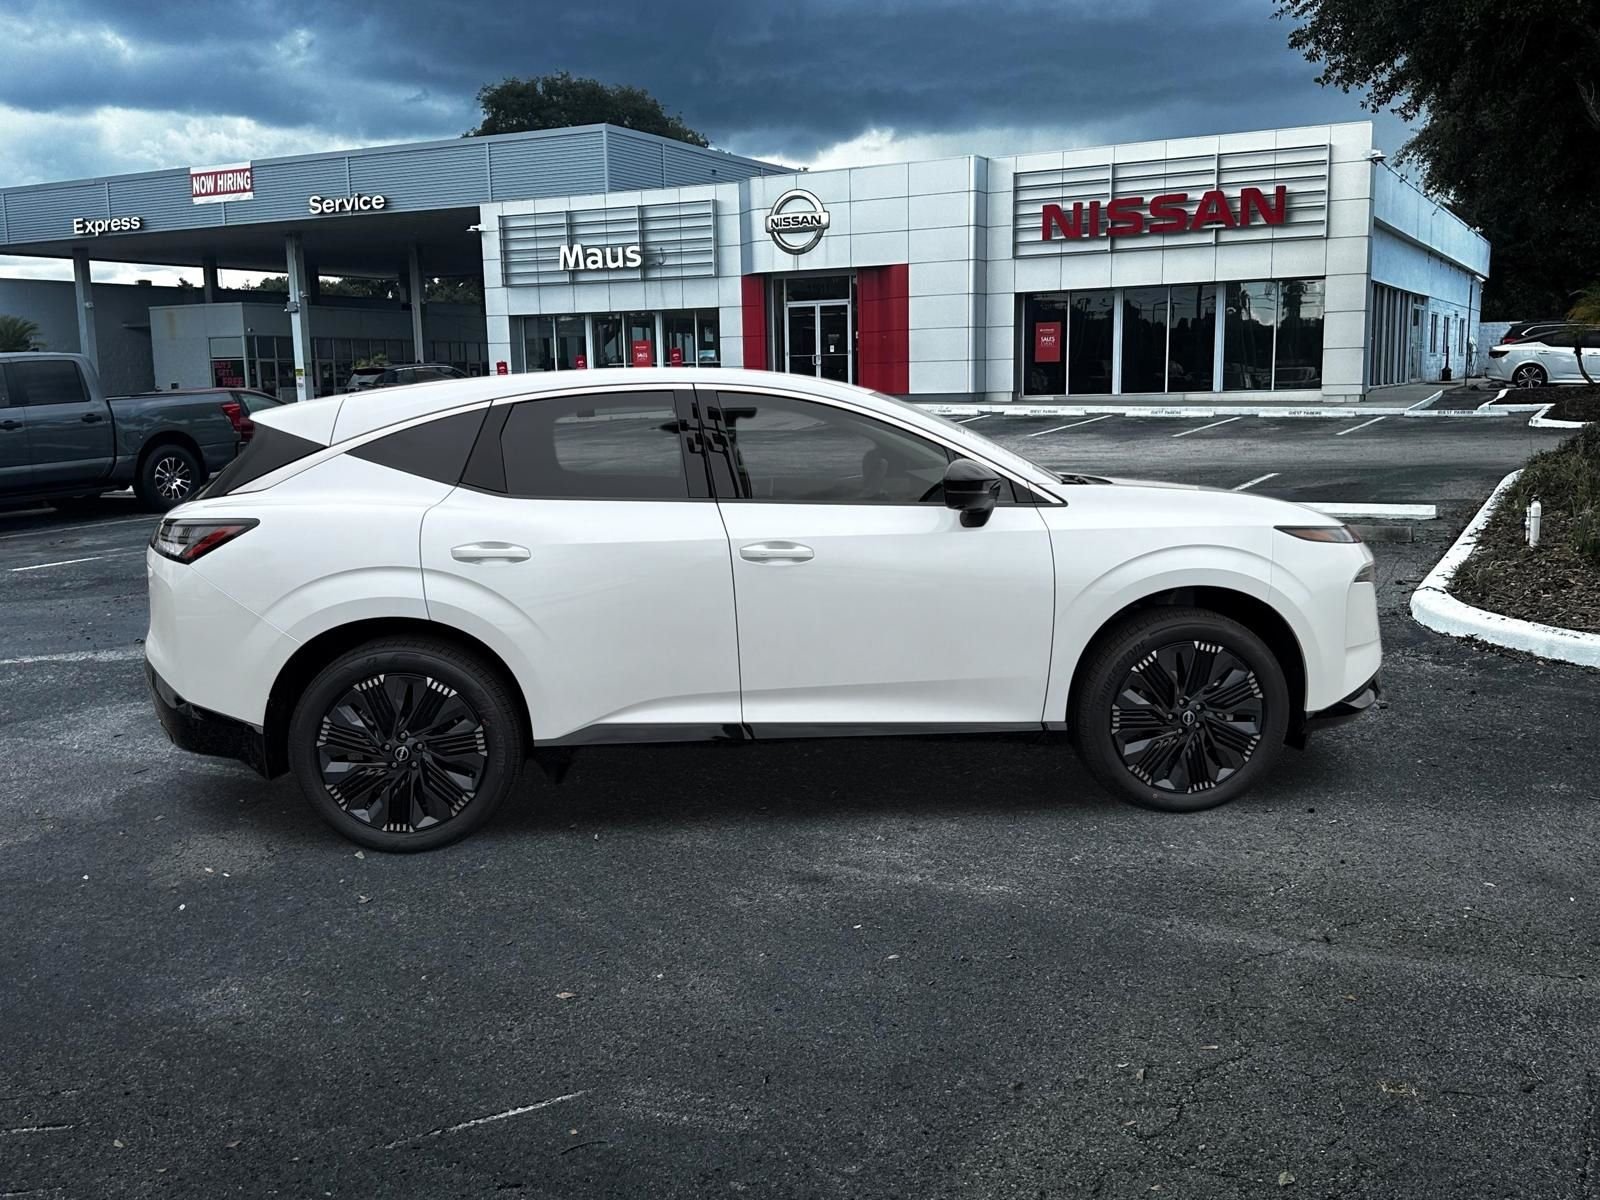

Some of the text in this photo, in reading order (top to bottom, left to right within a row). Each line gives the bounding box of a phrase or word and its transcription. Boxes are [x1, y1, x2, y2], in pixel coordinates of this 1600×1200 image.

[192, 170, 251, 195] NOW HIRING
[308, 192, 385, 214] Service
[1041, 185, 1287, 241] NISSAN
[73, 216, 141, 236] Express
[770, 215, 822, 228] NISSAN
[559, 243, 642, 271] Maus
